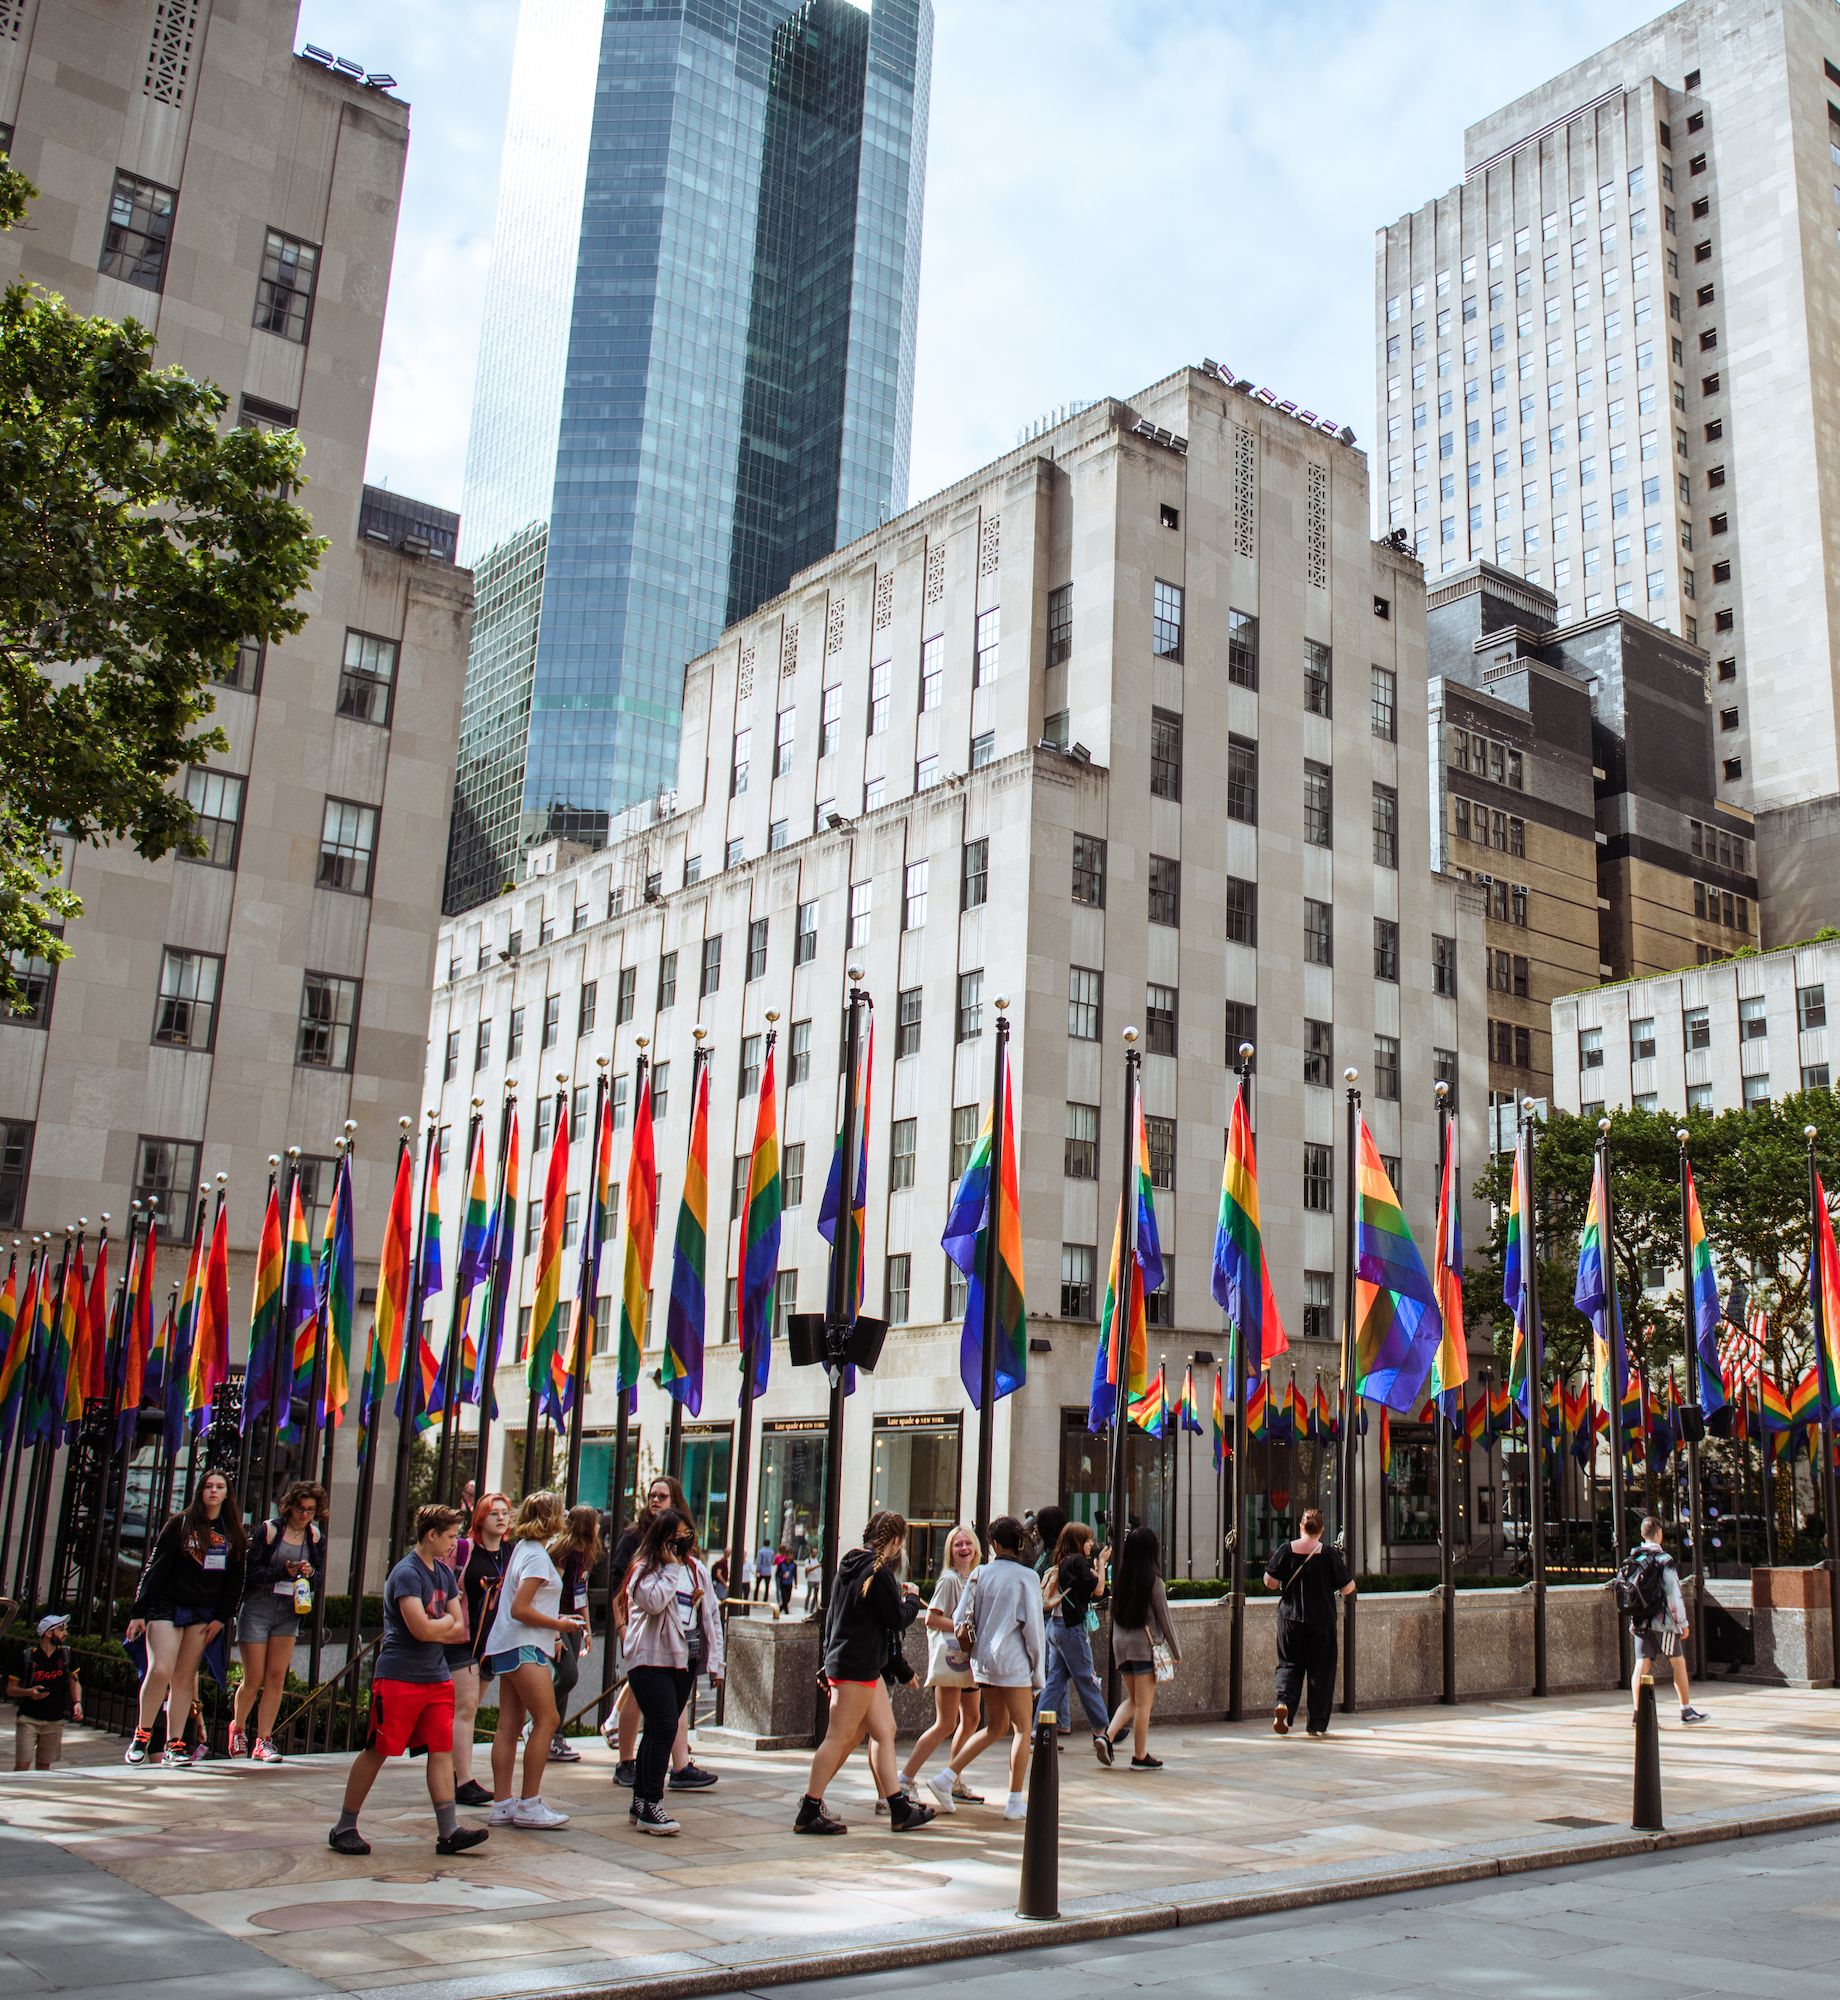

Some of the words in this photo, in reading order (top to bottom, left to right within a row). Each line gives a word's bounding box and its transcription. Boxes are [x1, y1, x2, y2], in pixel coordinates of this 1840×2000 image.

[774, 1421, 785, 1431] kate
[785, 1421, 798, 1432] spade
[887, 1417, 898, 1426] kate
[899, 1416, 914, 1427] spade
[931, 1416, 945, 1424] YORK
